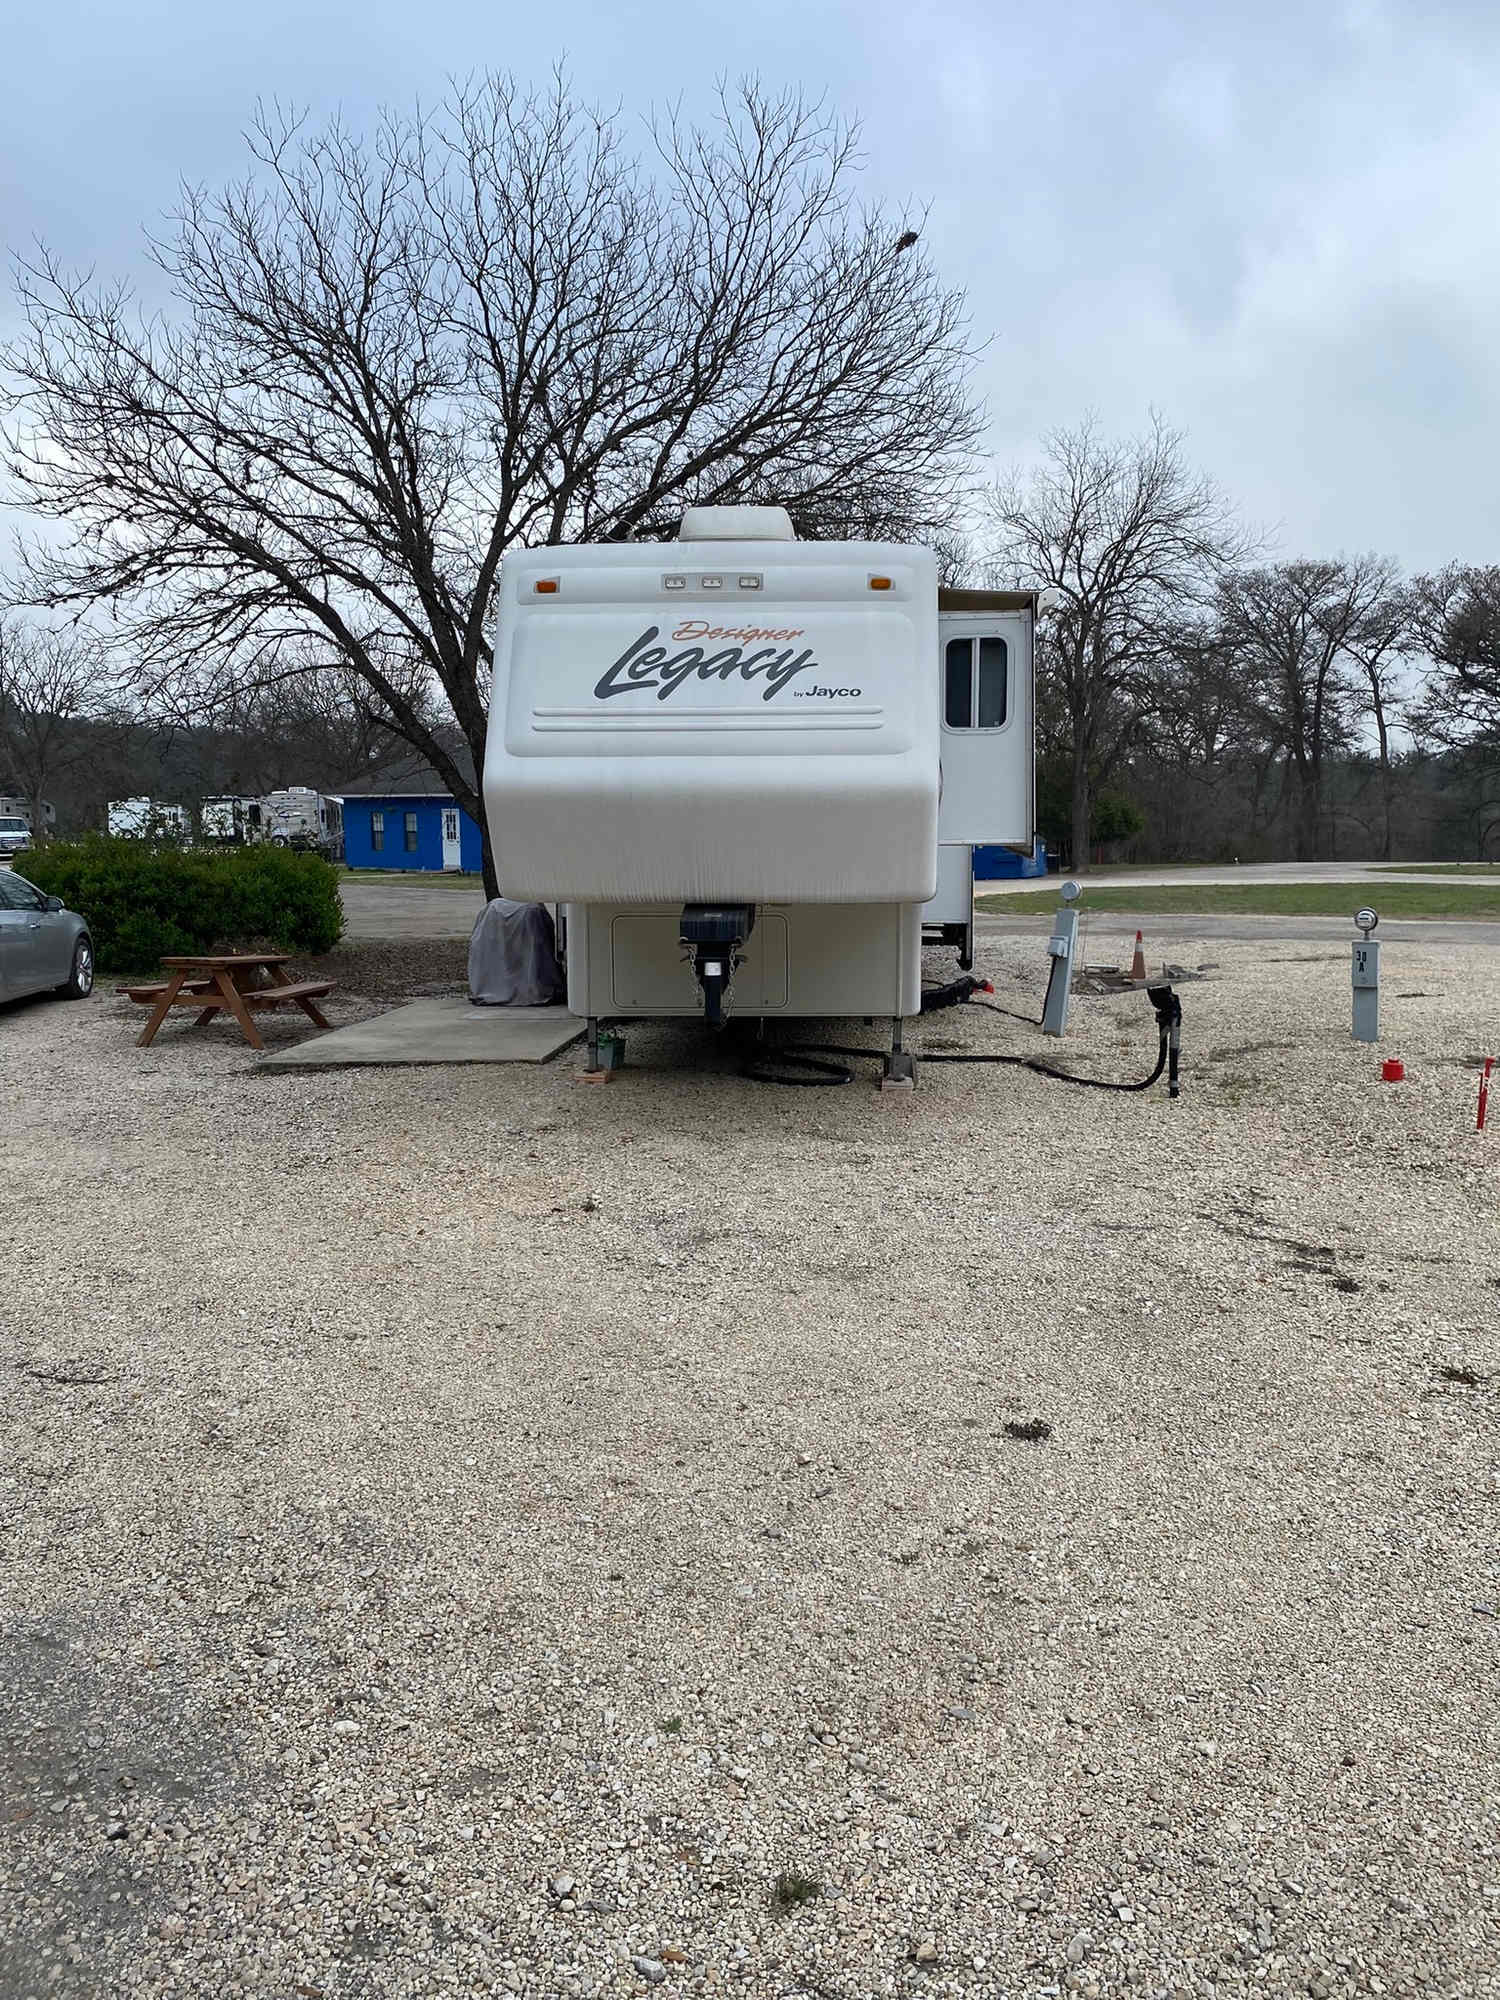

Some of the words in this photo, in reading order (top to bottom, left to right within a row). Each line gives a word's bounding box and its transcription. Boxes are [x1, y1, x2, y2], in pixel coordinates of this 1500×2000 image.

[671, 620, 804, 647] Designer
[594, 626, 818, 701] Legacy
[805, 685, 862, 699] Jayco
